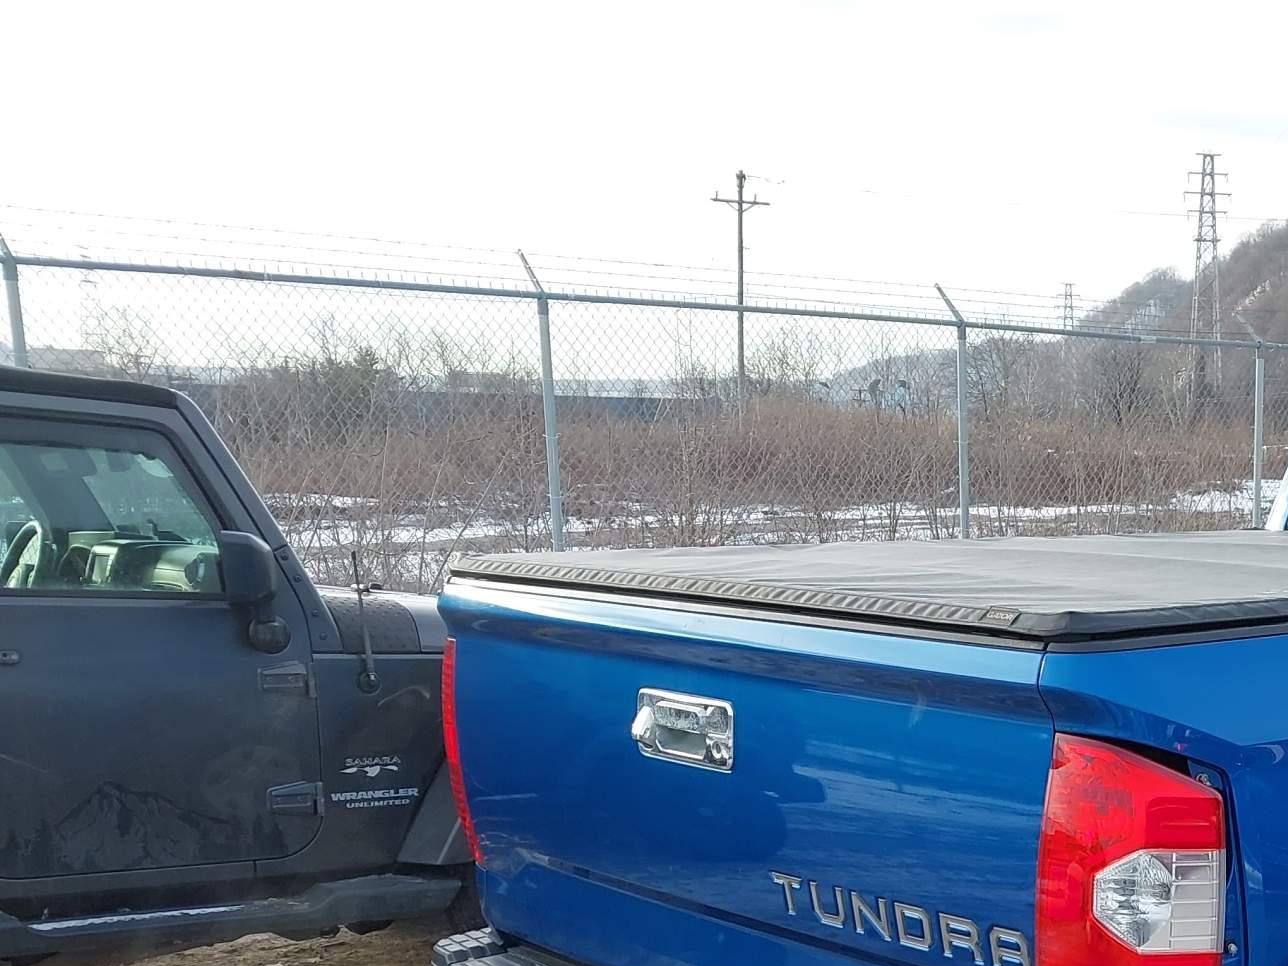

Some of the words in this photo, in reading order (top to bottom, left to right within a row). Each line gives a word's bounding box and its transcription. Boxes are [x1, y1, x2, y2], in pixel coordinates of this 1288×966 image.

[344, 756, 401, 767] SAHARA
[331, 788, 420, 801] WRANGLER
[346, 799, 410, 809] UNLIMITED
